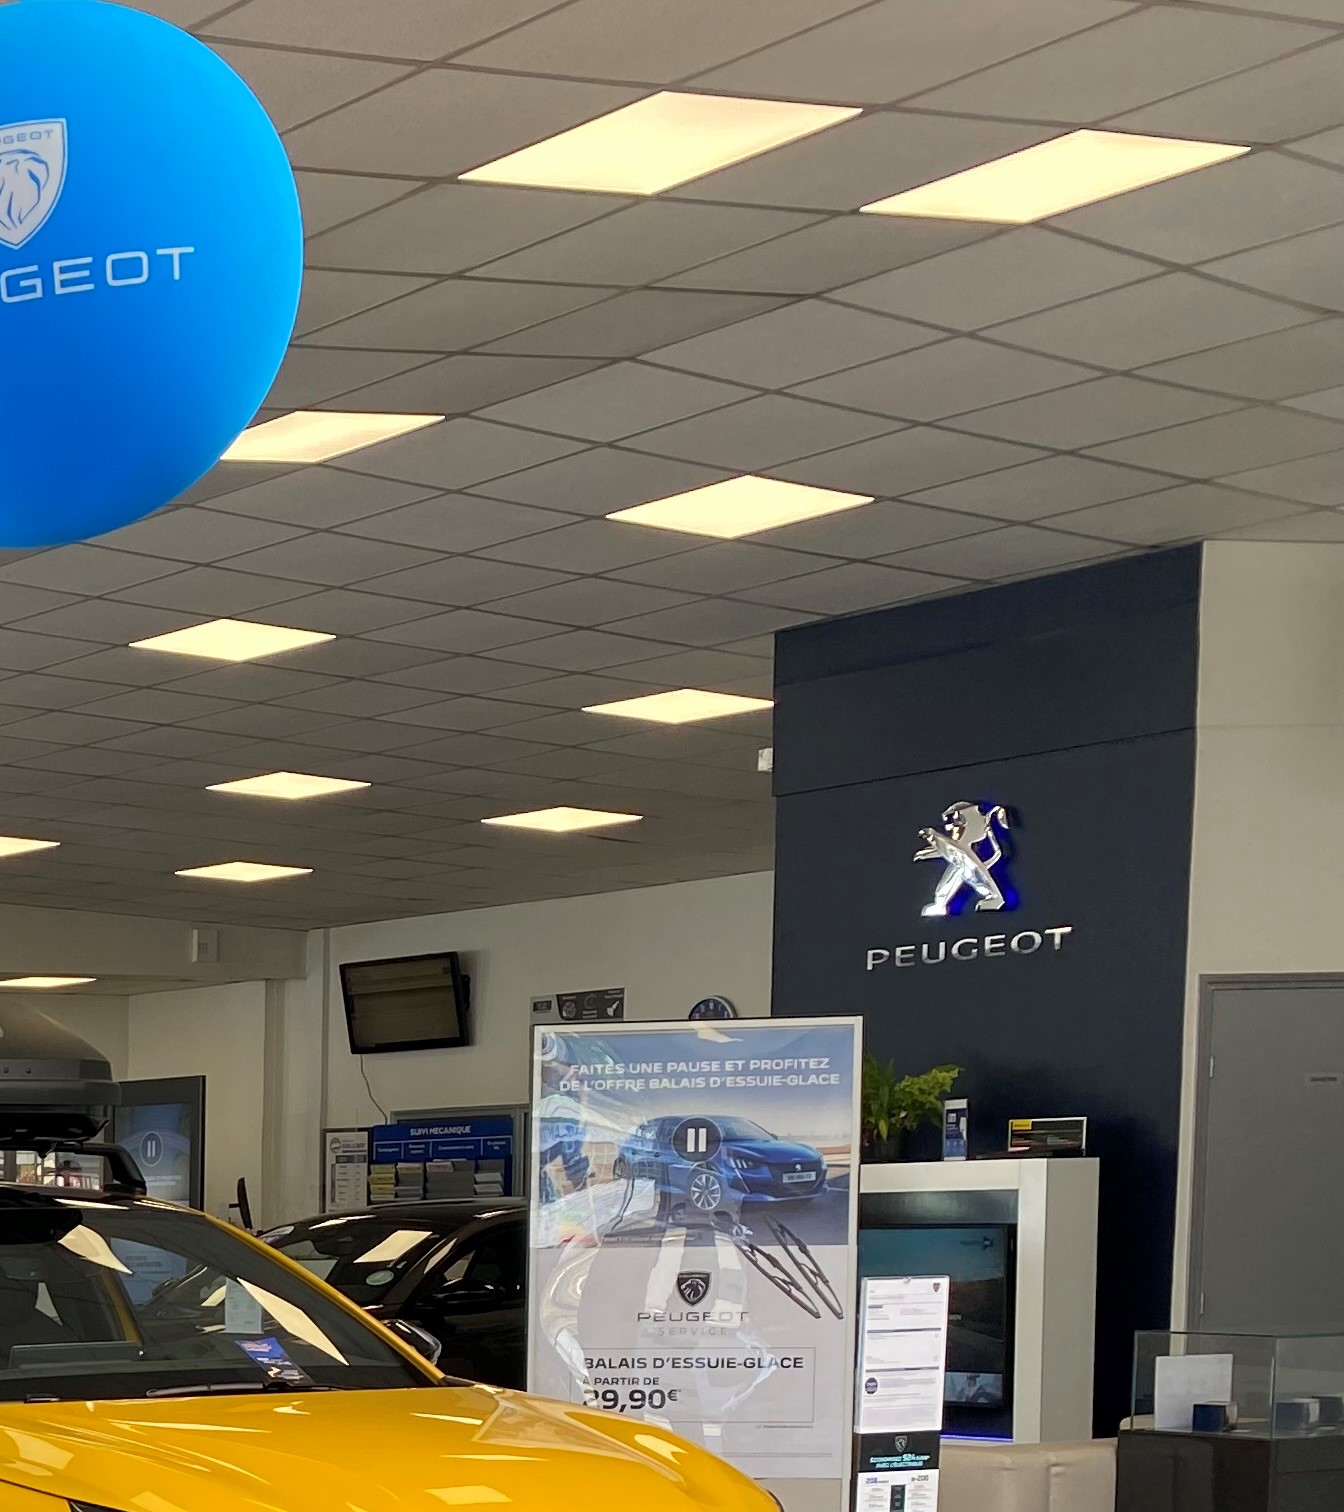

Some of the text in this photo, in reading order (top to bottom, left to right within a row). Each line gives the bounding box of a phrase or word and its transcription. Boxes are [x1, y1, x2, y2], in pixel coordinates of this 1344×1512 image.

[865, 925, 1074, 971] PEUGEOT
[569, 1057, 831, 1075] FAITES UNE PAUSE ET PROFITEZ
[559, 1073, 841, 1092] DE L'OFFRE BALAIS D'ESSUIE-GLACE
[637, 1311, 750, 1323] PEUGEOT
[658, 1326, 728, 1337] SERVICE
[584, 1356, 805, 1369] BALAIS D'ESSUIE-GLACE
[593, 1376, 640, 1386] PARTIR
[643, 1376, 660, 1386] DE
